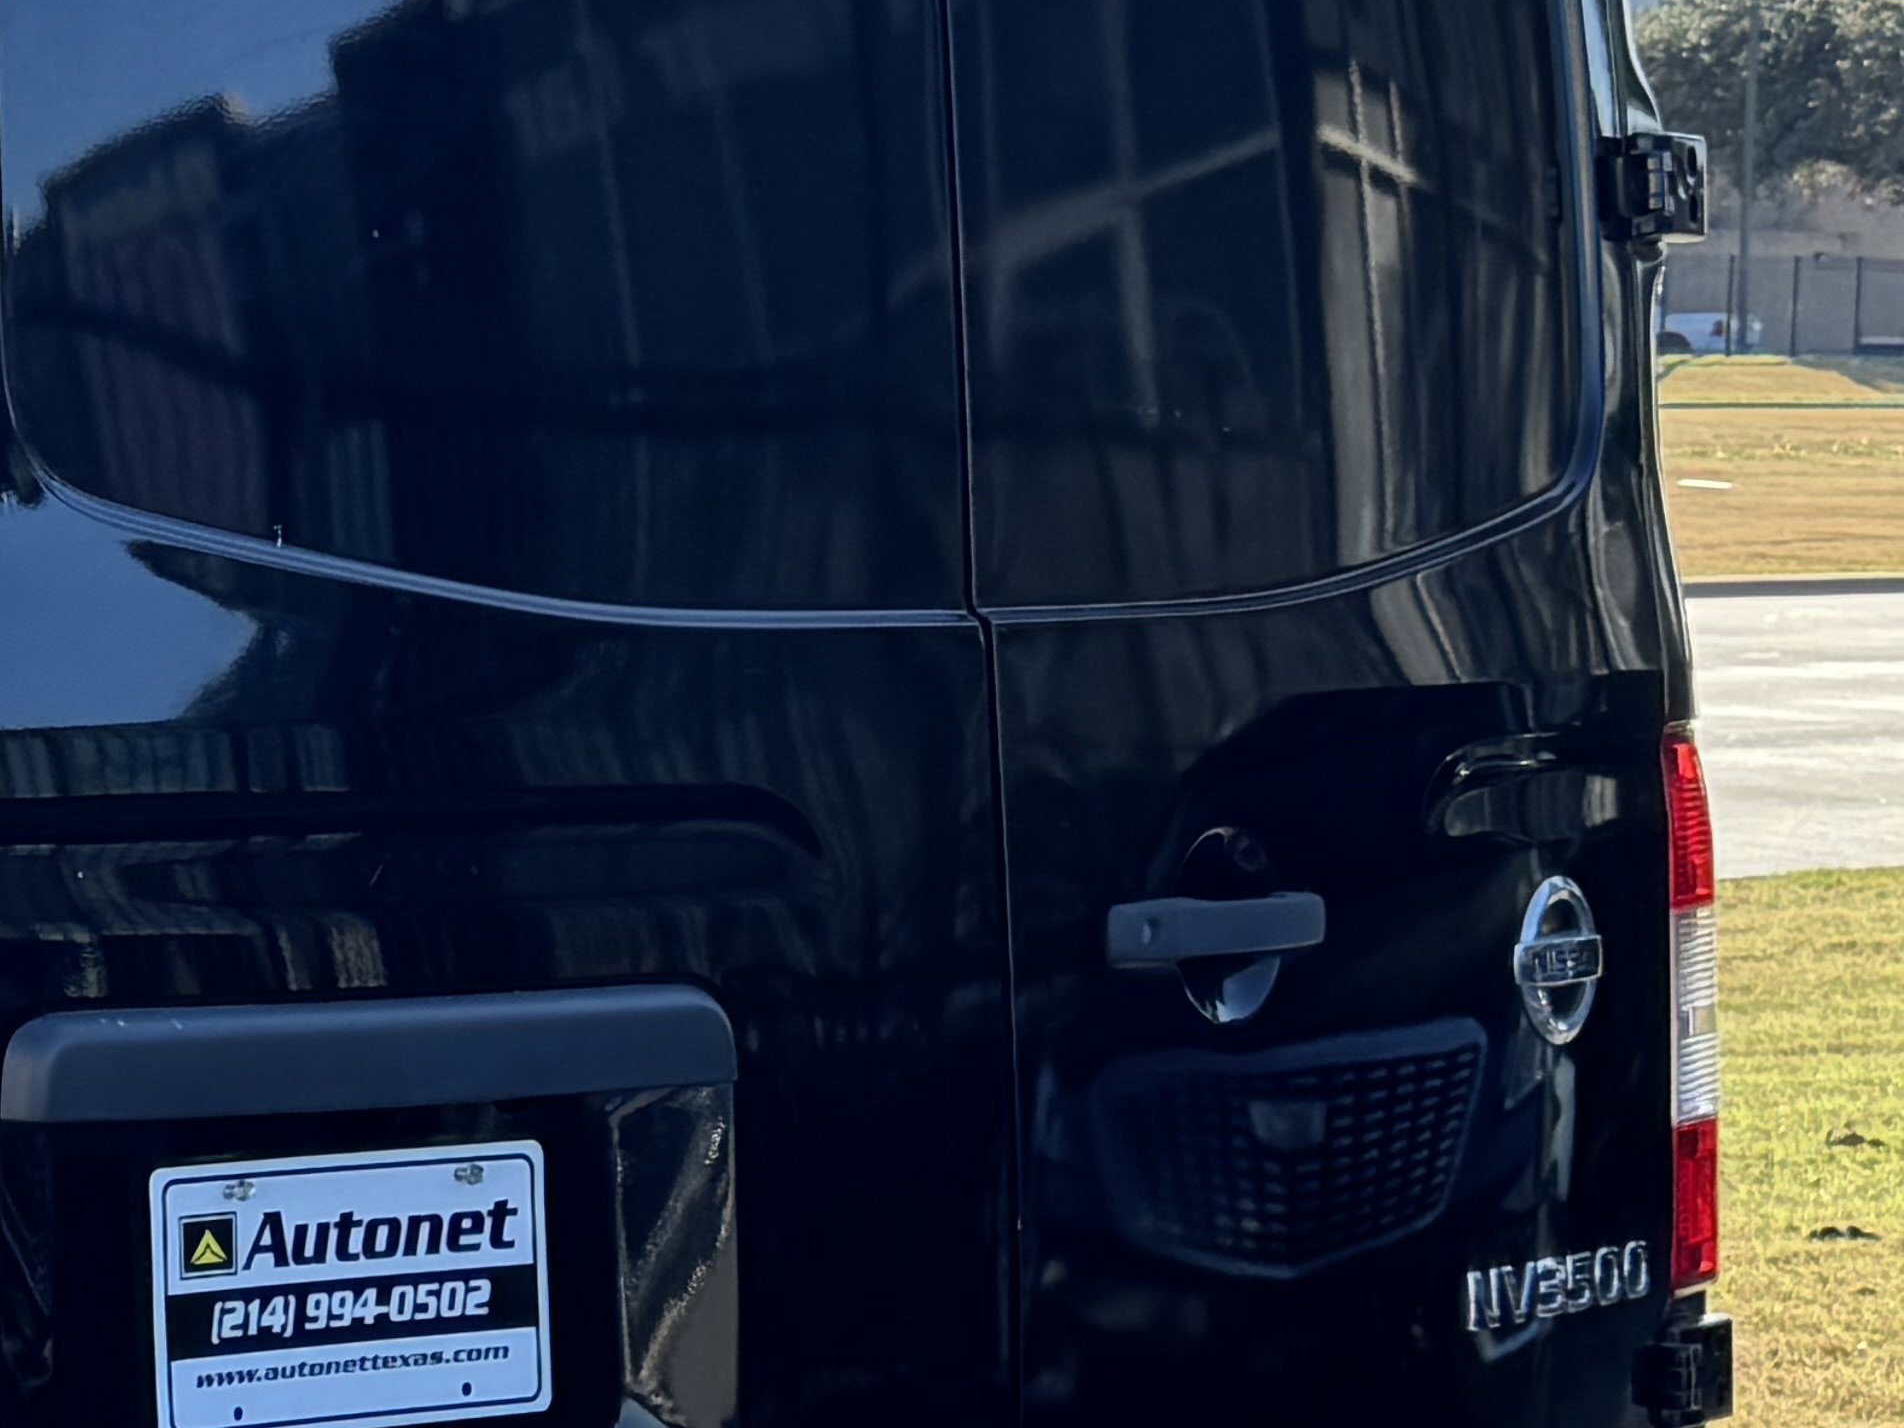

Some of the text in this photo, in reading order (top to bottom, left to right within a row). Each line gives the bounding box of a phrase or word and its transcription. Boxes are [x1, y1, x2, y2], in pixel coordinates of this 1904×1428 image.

[242, 1199, 518, 1271] Autonet
[210, 1279, 492, 1345] (214) 994-0502
[1466, 1240, 1650, 1332] NV3500
[196, 1344, 510, 1389] www.autonettexas.com
